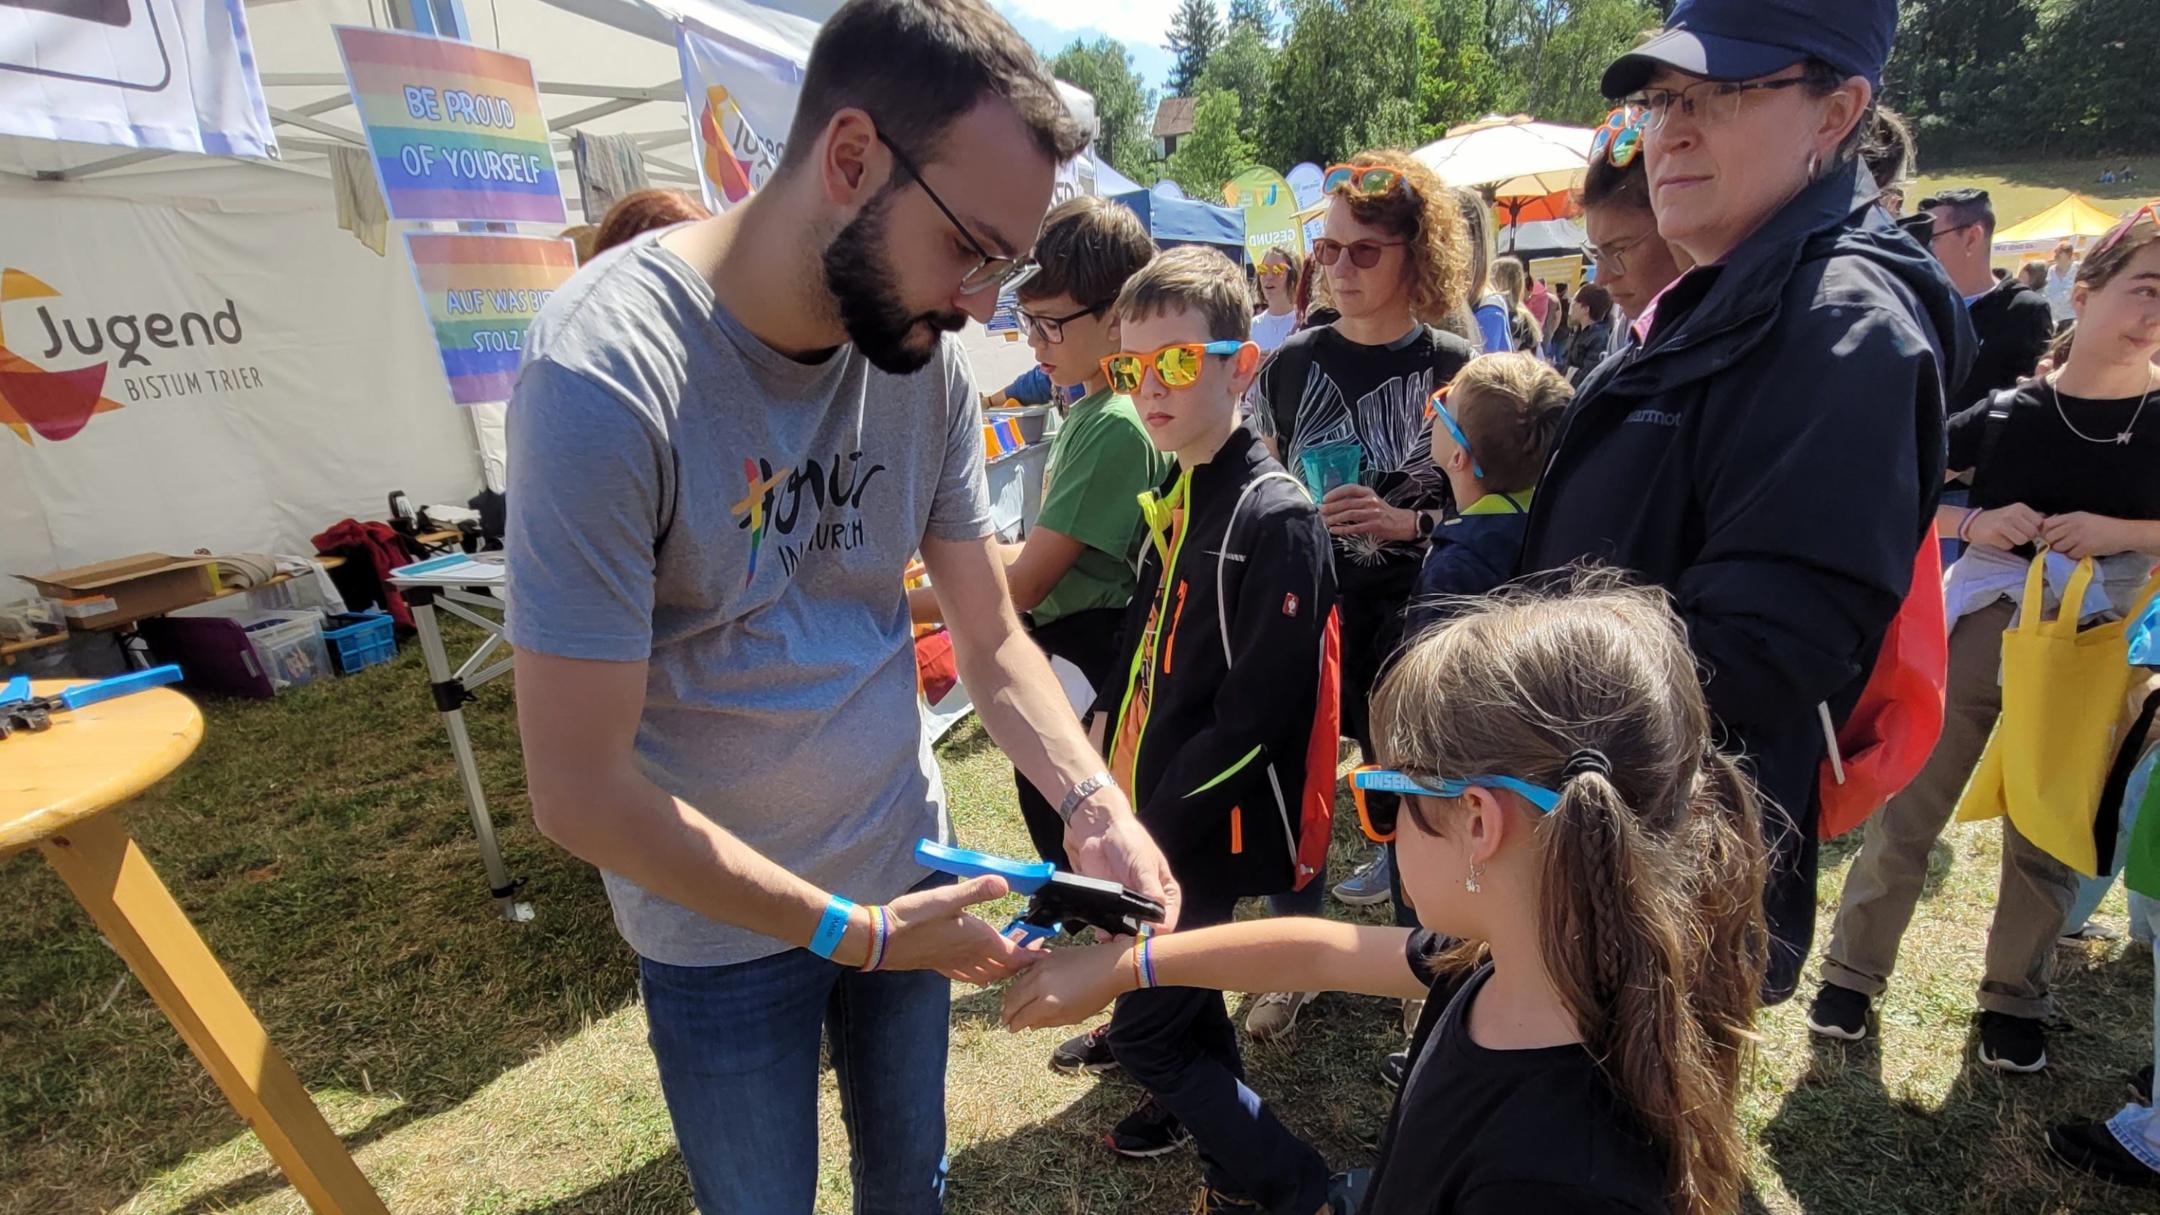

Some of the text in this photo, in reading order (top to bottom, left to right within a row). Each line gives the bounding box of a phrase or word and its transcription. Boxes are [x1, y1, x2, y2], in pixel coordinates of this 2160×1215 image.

[404, 86, 516, 129] BE PROUD
[400, 144, 541, 184] OF YOURSELF
[446, 288, 484, 315] AUF
[486, 288, 527, 314] WAS
[36, 298, 242, 369] Jugend
[472, 330, 522, 353] STOLZ
[124, 366, 263, 401] BISTUM TRIER
